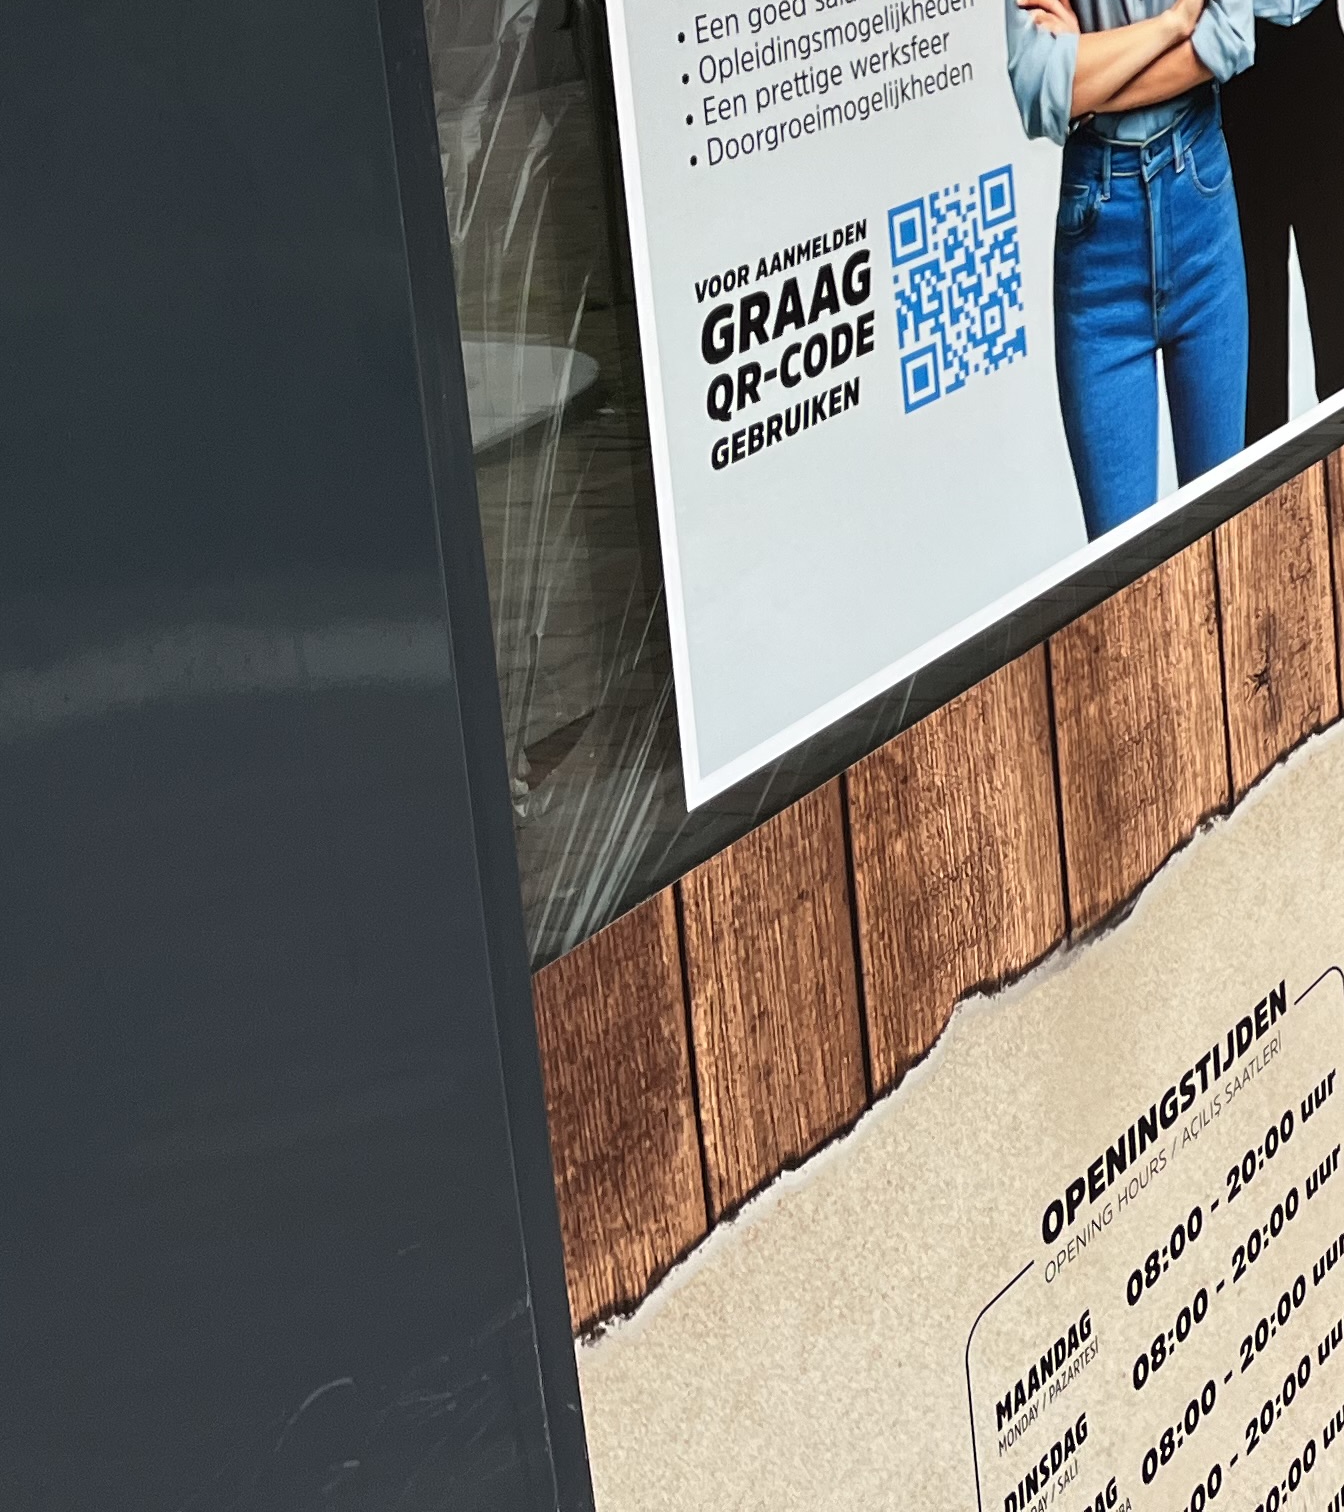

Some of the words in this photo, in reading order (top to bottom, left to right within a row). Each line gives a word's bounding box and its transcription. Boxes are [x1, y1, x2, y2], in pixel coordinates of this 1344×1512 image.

[694, 12, 740, 45] Een
[702, 93, 748, 127] Een
[755, 64, 843, 115] prettige
[848, 31, 951, 81] werksfeer
[706, 62, 974, 167] Doorgroeimogelijkheden
[693, 263, 751, 305] VOOR
[754, 217, 868, 282] AANMELDEN
[700, 248, 872, 366] GRAAG
[706, 309, 876, 423] QR-CODE
[710, 375, 861, 471] GEBRUIKEN
[1042, 979, 1288, 1245] OPENINGSTIJDEN
[1044, 1203, 1113, 1284] OPENING
[1118, 1149, 1168, 1215] HOURS
[1182, 1093, 1222, 1149] AÇILIŞ
[995, 1308, 1092, 1432] MAANDAG
[1126, 1205, 1203, 1306] 08:00
[1209, 1198, 1220, 1214] -
[1226, 1108, 1295, 1203] 20:00
[1300, 1068, 1337, 1123] uur
[1004, 1411, 1089, 1512] DINSDAG
[1132, 1287, 1209, 1391] 08:00
[1216, 1279, 1226, 1295] -
[1231, 1185, 1300, 1284] 20:00
[1305, 1143, 1342, 1200] uur
[1141, 1378, 1217, 1486] 08:00
[1223, 1369, 1233, 1385] -
[1239, 1273, 1307, 1373] 20:00
[998, 1398, 1040, 1458] MONDAY
[1245, 1354, 1311, 1457] 20:00
[1057, 1457, 1079, 1495] SALI
[1255, 1438, 1317, 1512] 0:00
